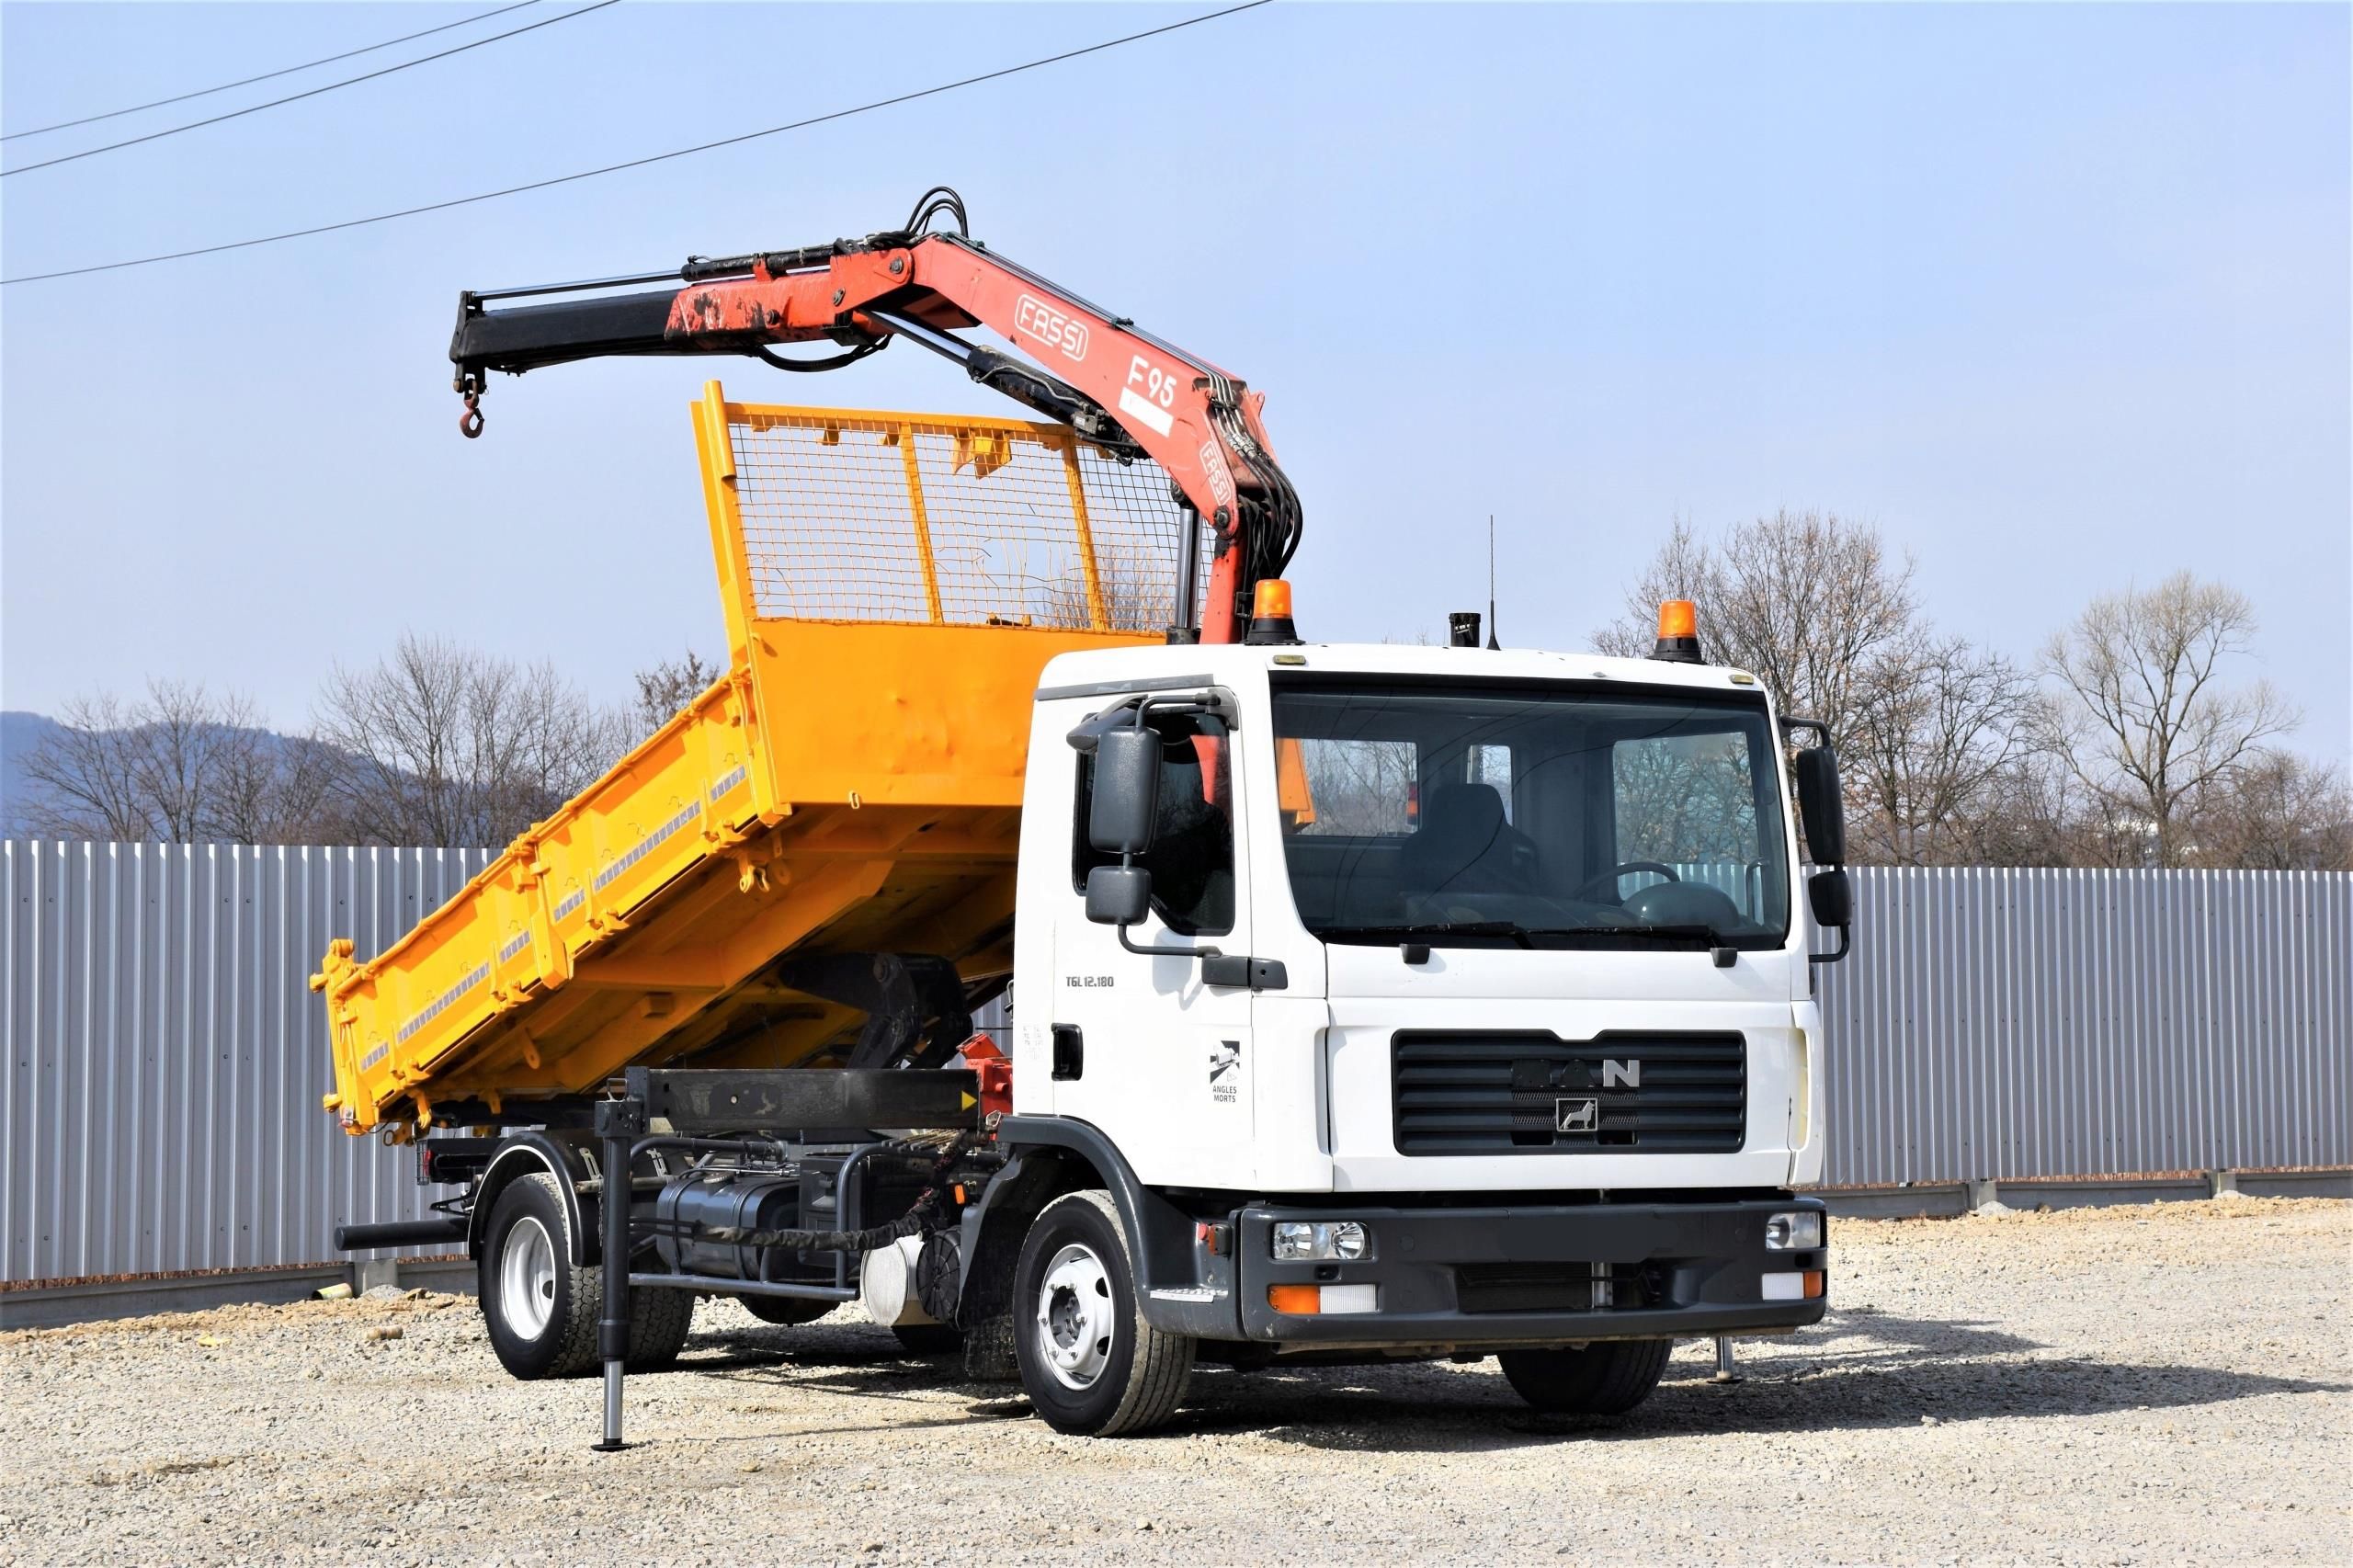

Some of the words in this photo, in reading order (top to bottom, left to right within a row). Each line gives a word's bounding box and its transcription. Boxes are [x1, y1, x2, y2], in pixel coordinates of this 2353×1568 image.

[1018, 300, 1084, 355] FASSI
[1202, 447, 1229, 502] FASSI
[1212, 1085, 1237, 1095] ANGLES
[1213, 1095, 1236, 1103] MORTS
